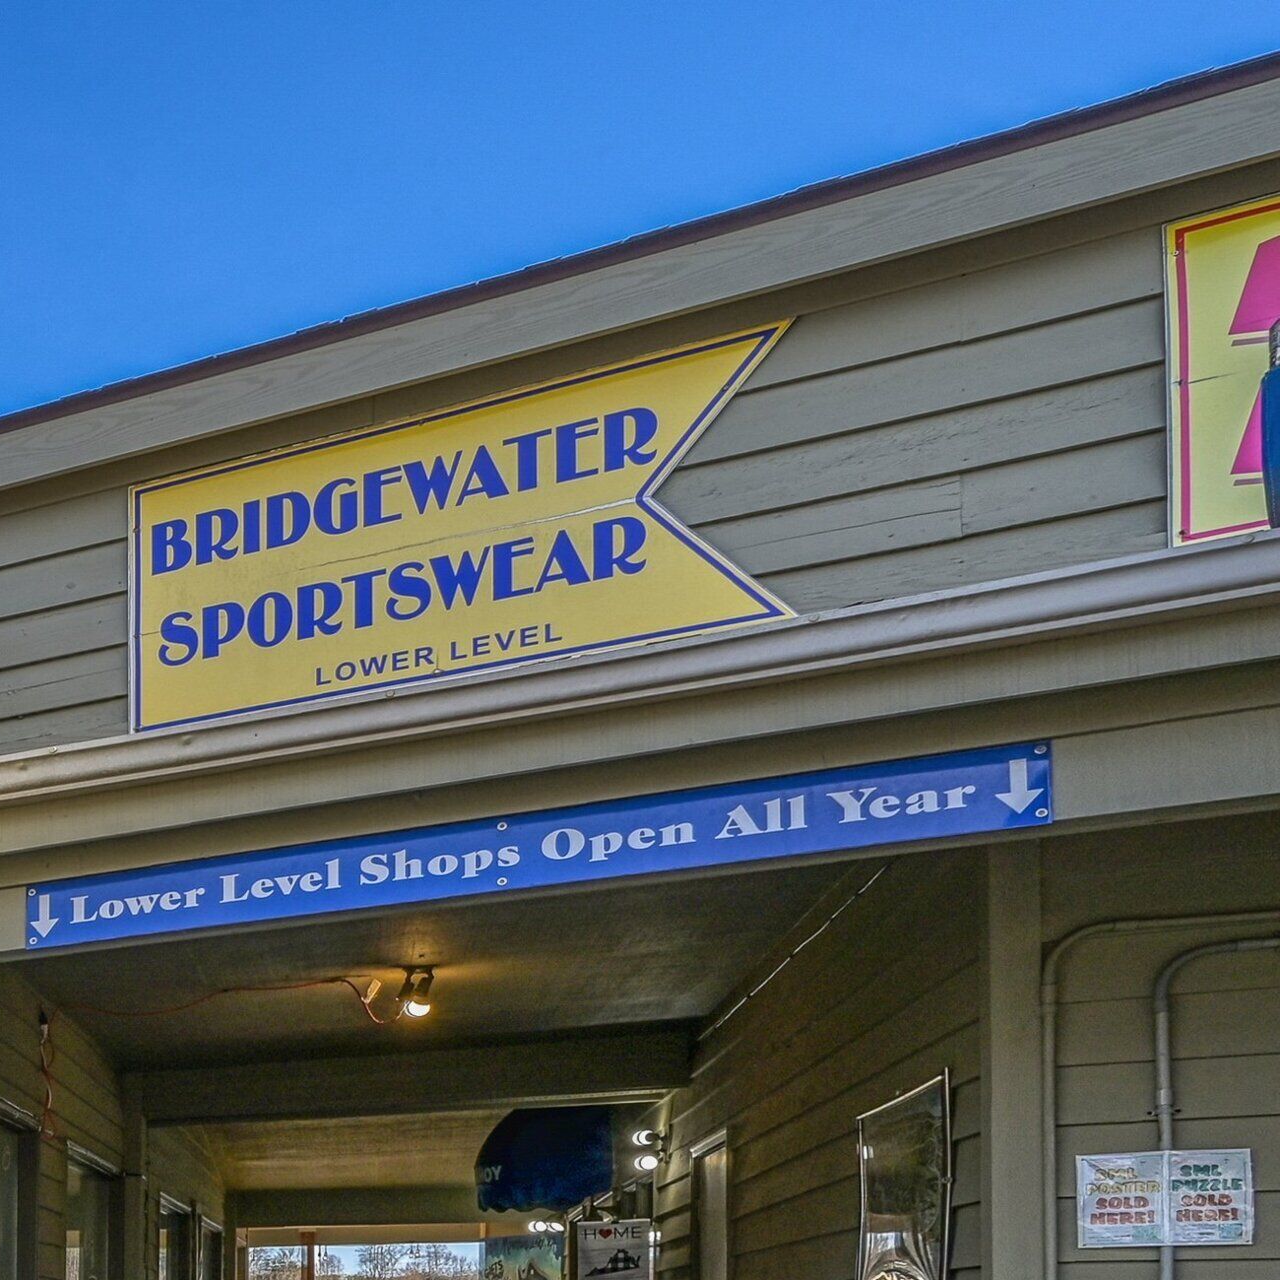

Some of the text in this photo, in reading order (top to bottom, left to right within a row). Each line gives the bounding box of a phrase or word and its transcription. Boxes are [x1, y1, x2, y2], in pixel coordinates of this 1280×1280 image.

[151, 406, 659, 576] BRIDGEWATER
[157, 515, 648, 668] SPORTSWEAR
[315, 623, 563, 686] LOWER LEVEL
[69, 785, 977, 925] Lower Level Shops Open All Year
[1179, 1164, 1223, 1178] SML
[1085, 1180, 1162, 1196] POSTER
[1171, 1178, 1244, 1193] PUZZLE
[1095, 1196, 1150, 1210] SOLD
[1181, 1193, 1234, 1207] SOLD
[1090, 1210, 1156, 1225] HERE!
[1175, 1207, 1241, 1223] HERE!
